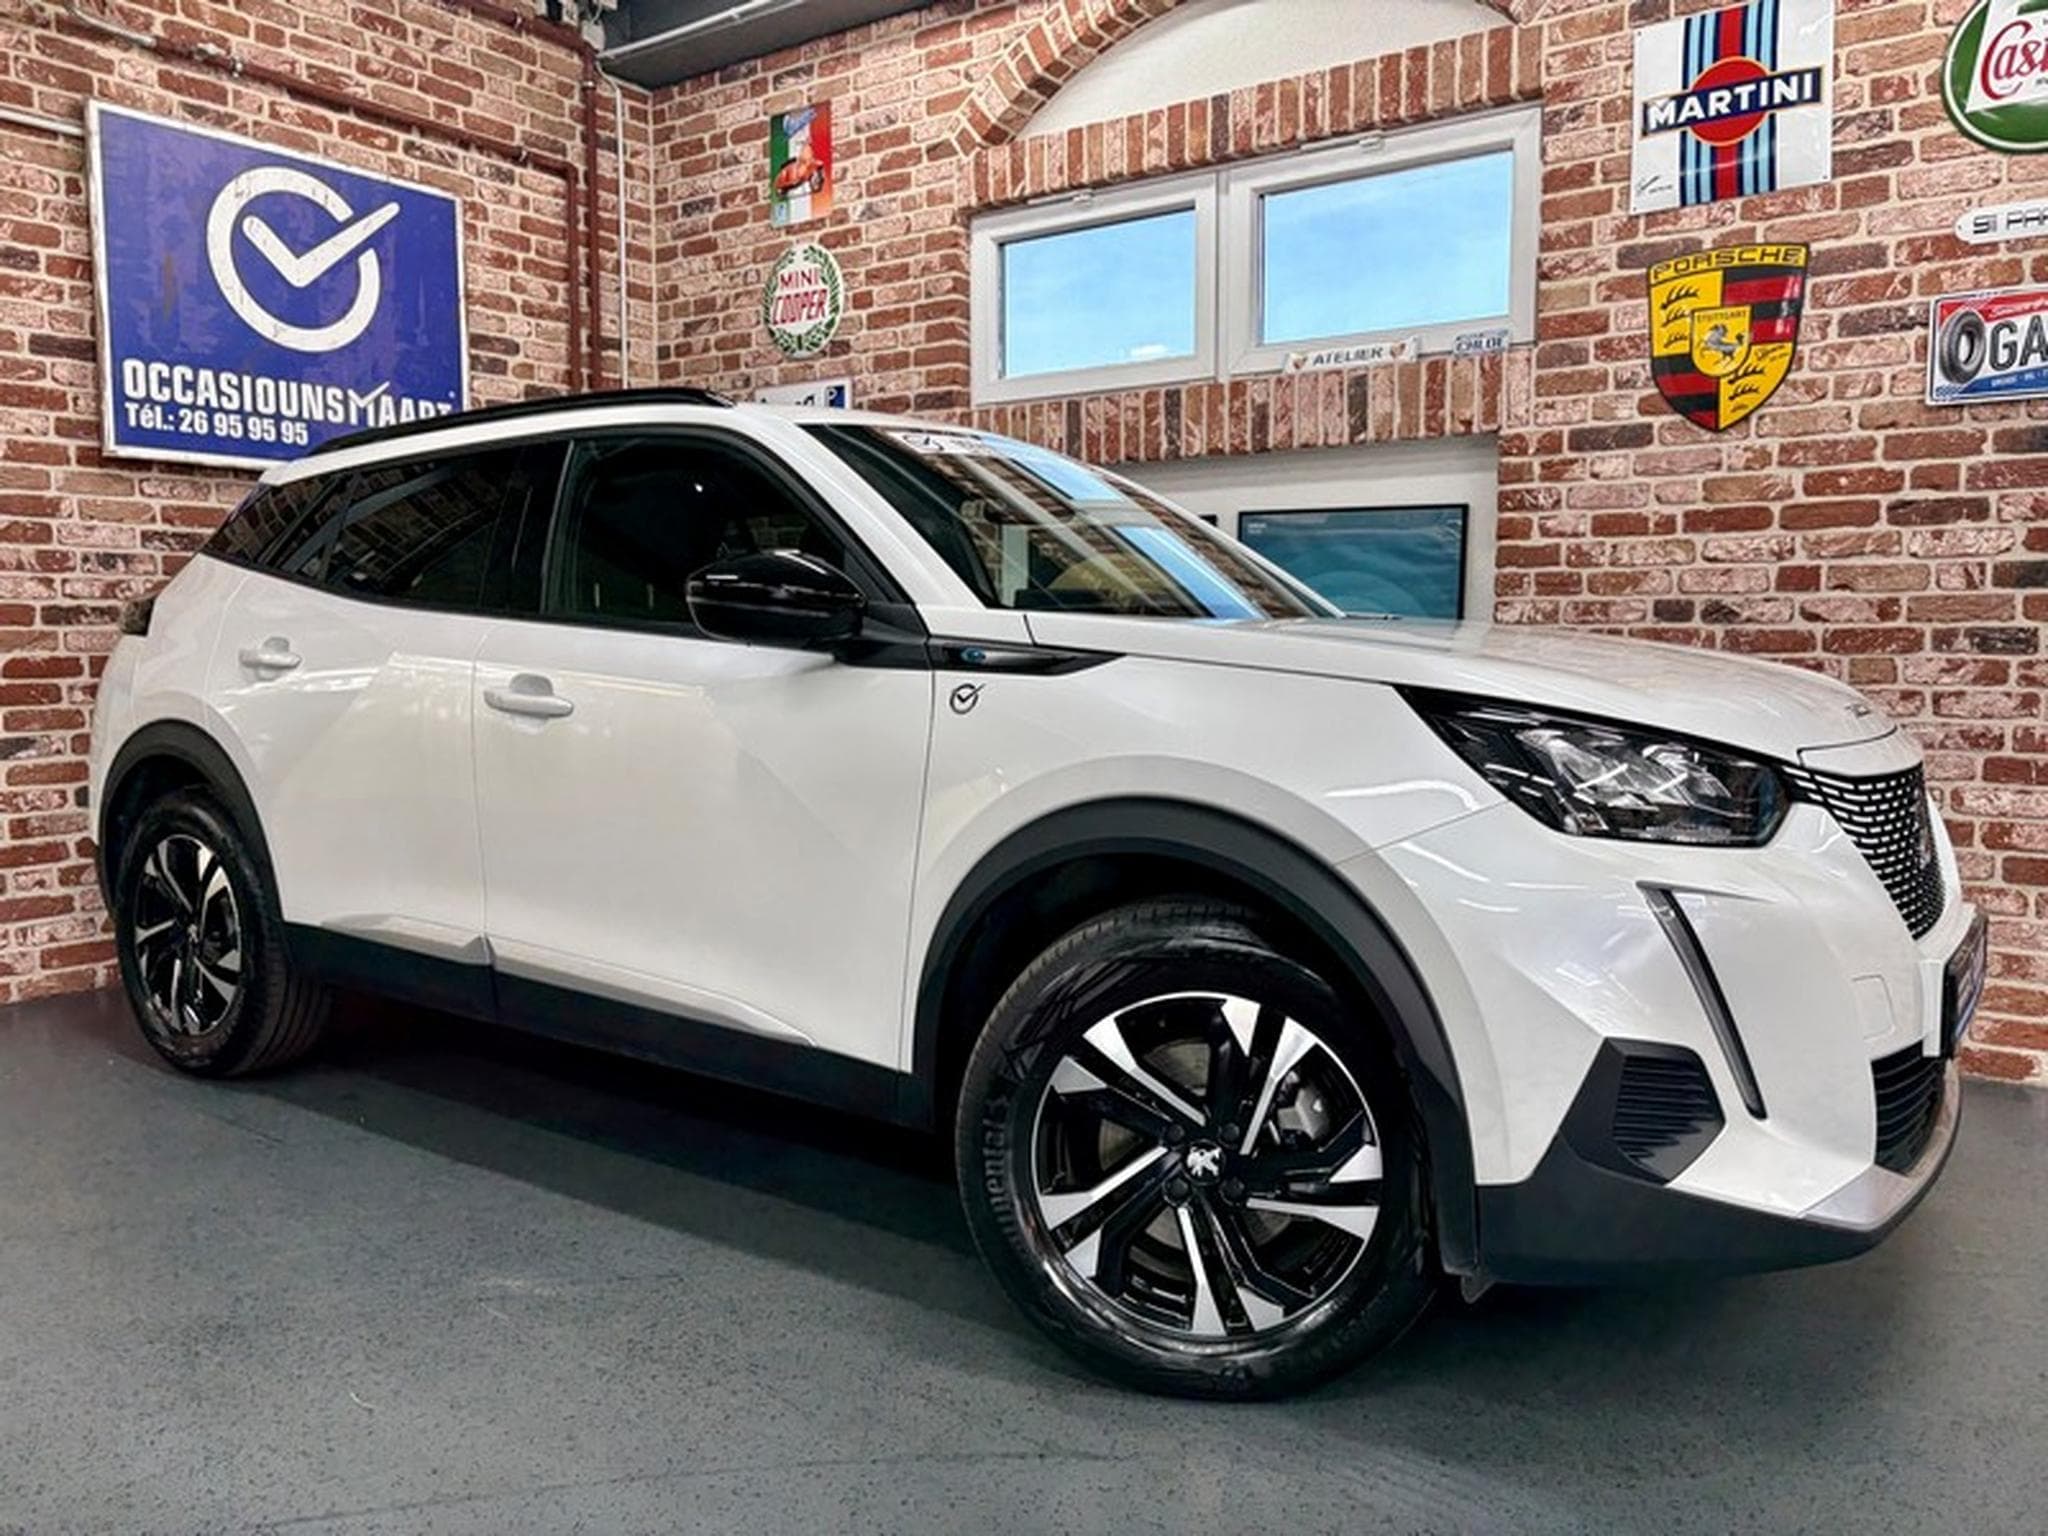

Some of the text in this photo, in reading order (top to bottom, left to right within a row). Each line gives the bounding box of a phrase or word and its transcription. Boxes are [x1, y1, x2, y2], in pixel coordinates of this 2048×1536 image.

[1649, 73, 1812, 130] MARTINI
[779, 267, 819, 289] MINI
[1653, 247, 1800, 280] PORSCHE
[772, 287, 828, 325] COOPER
[122, 358, 453, 429] OCCASIOUNSMAA
[178, 408, 209, 435] 26
[213, 412, 243, 439] 95
[247, 416, 277, 442] 95
[280, 420, 309, 446] 95
